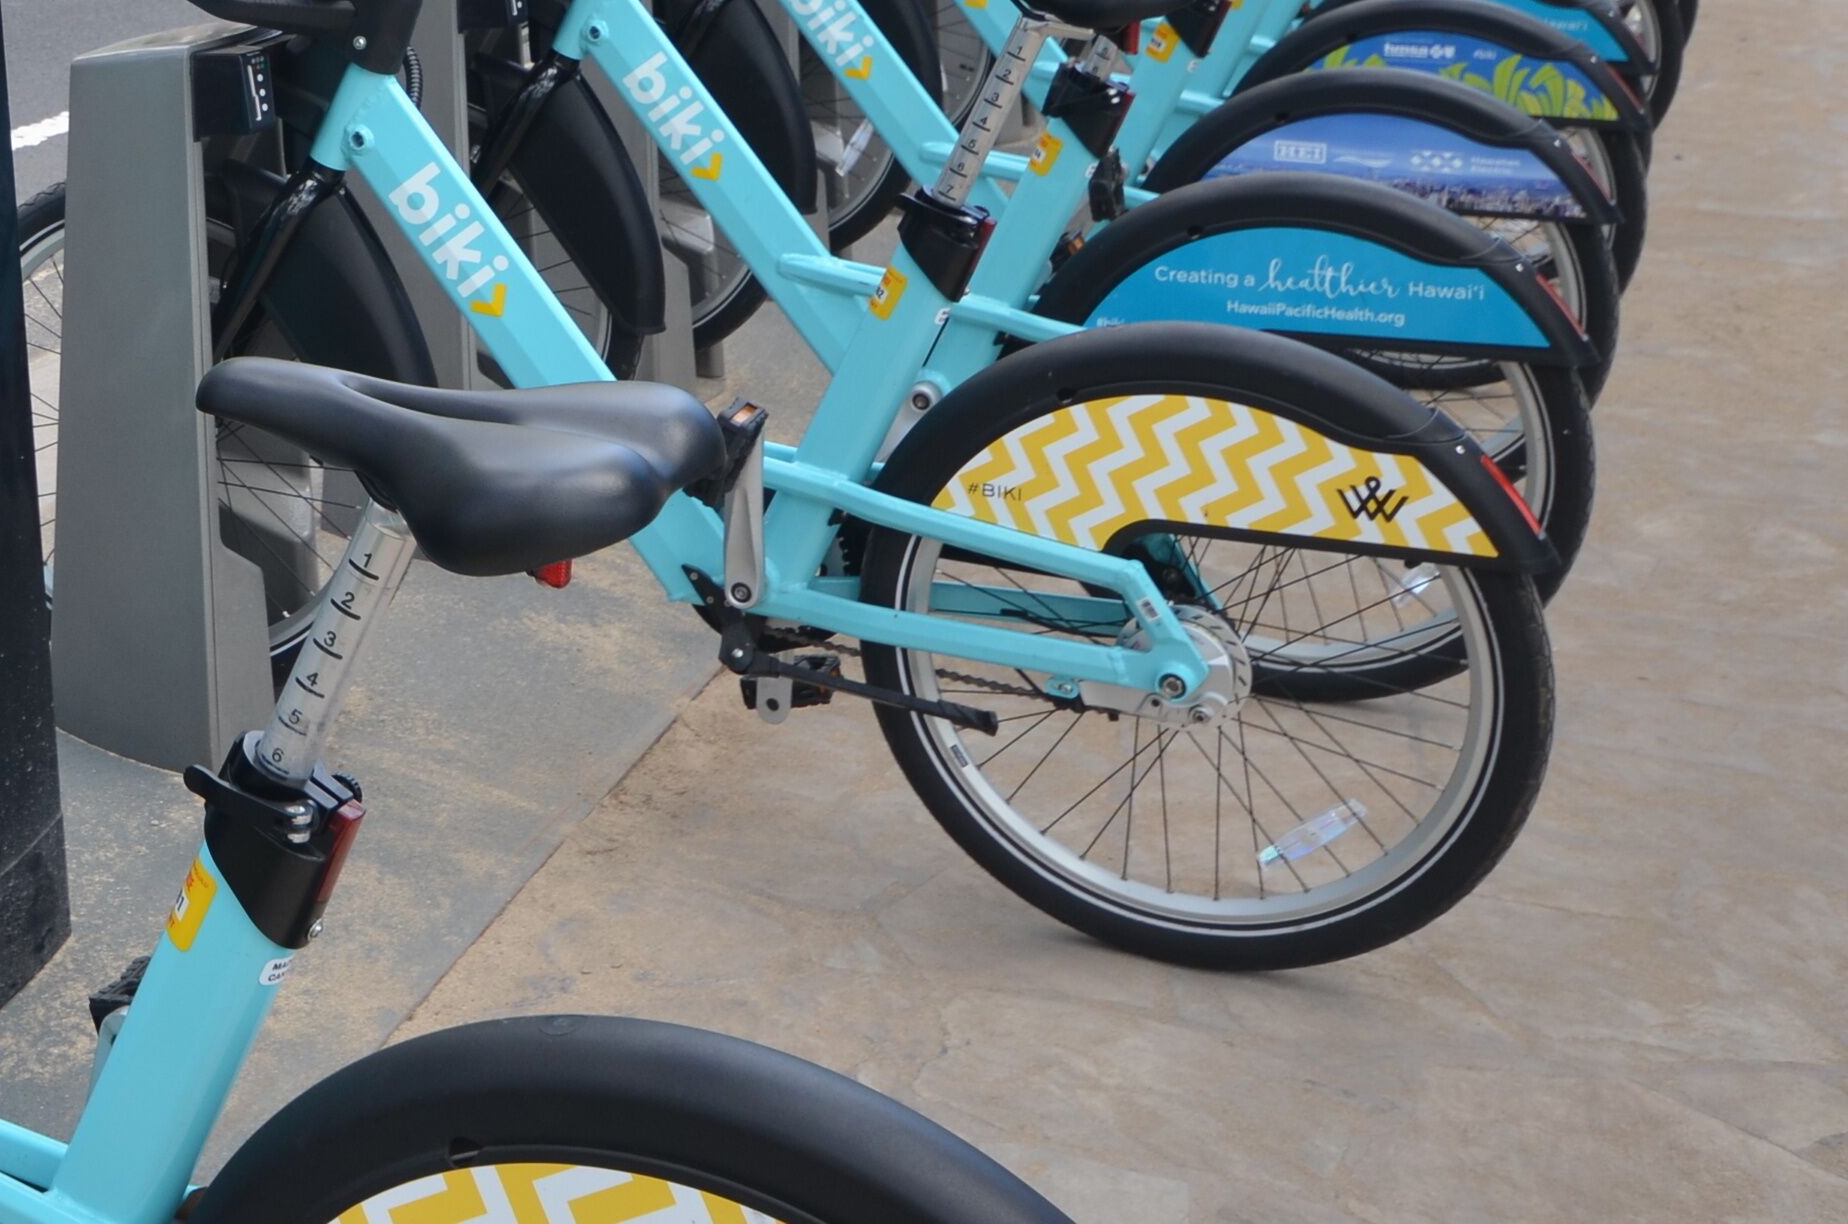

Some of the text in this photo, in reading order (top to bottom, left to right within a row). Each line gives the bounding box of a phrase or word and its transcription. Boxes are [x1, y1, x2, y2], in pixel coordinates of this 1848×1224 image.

[1016, 46, 1022, 55] 1
[1003, 69, 1012, 79] 2
[991, 92, 999, 103] 3
[622, 51, 725, 165] biki
[980, 116, 988, 126] 4
[946, 185, 954, 195] 7
[388, 161, 509, 298] biki
[1154, 265, 1239, 288] Creating
[1243, 274, 1255, 287] a
[1258, 254, 1402, 300] healthier
[1226, 299, 1406, 327] HawaiiPacificHealth.org
[968, 482, 1021, 501] #BIKI
[363, 553, 372, 568] 1
[341, 592, 355, 609] 2
[324, 631, 337, 647] 3
[307, 672, 319, 686] 4
[289, 709, 302, 724] 5
[271, 747, 284, 763] 6
